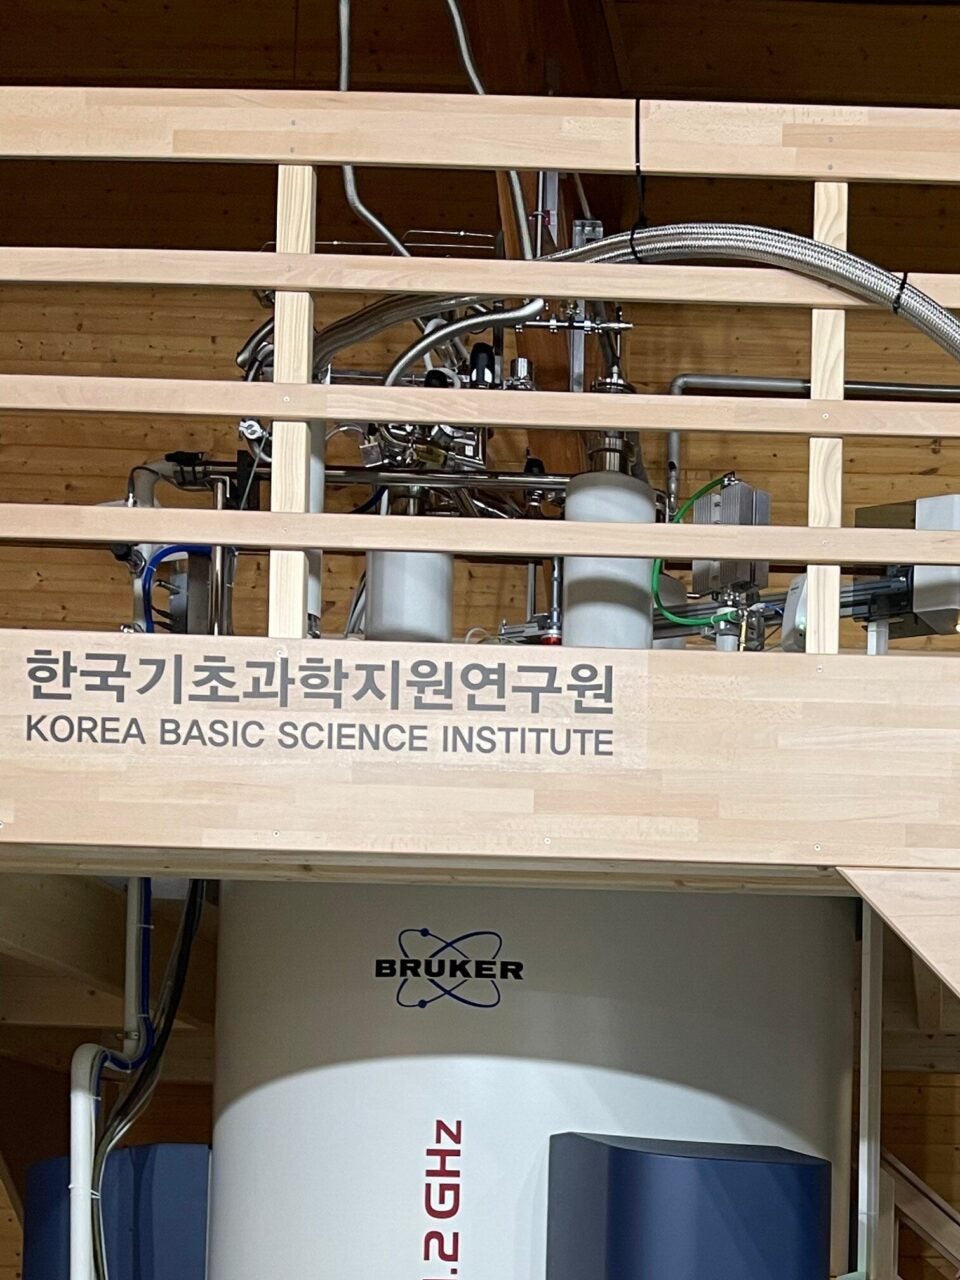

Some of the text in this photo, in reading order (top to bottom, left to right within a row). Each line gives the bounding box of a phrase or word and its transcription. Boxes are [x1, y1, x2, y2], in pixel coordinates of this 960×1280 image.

[26, 648, 613, 713] 한국기초과학지원연구원
[26, 714, 613, 756] KOREA BASIC SCIENCE INSTITUTE
[375, 958, 524, 981] BRUKER
[423, 1119, 462, 1219] GHz
